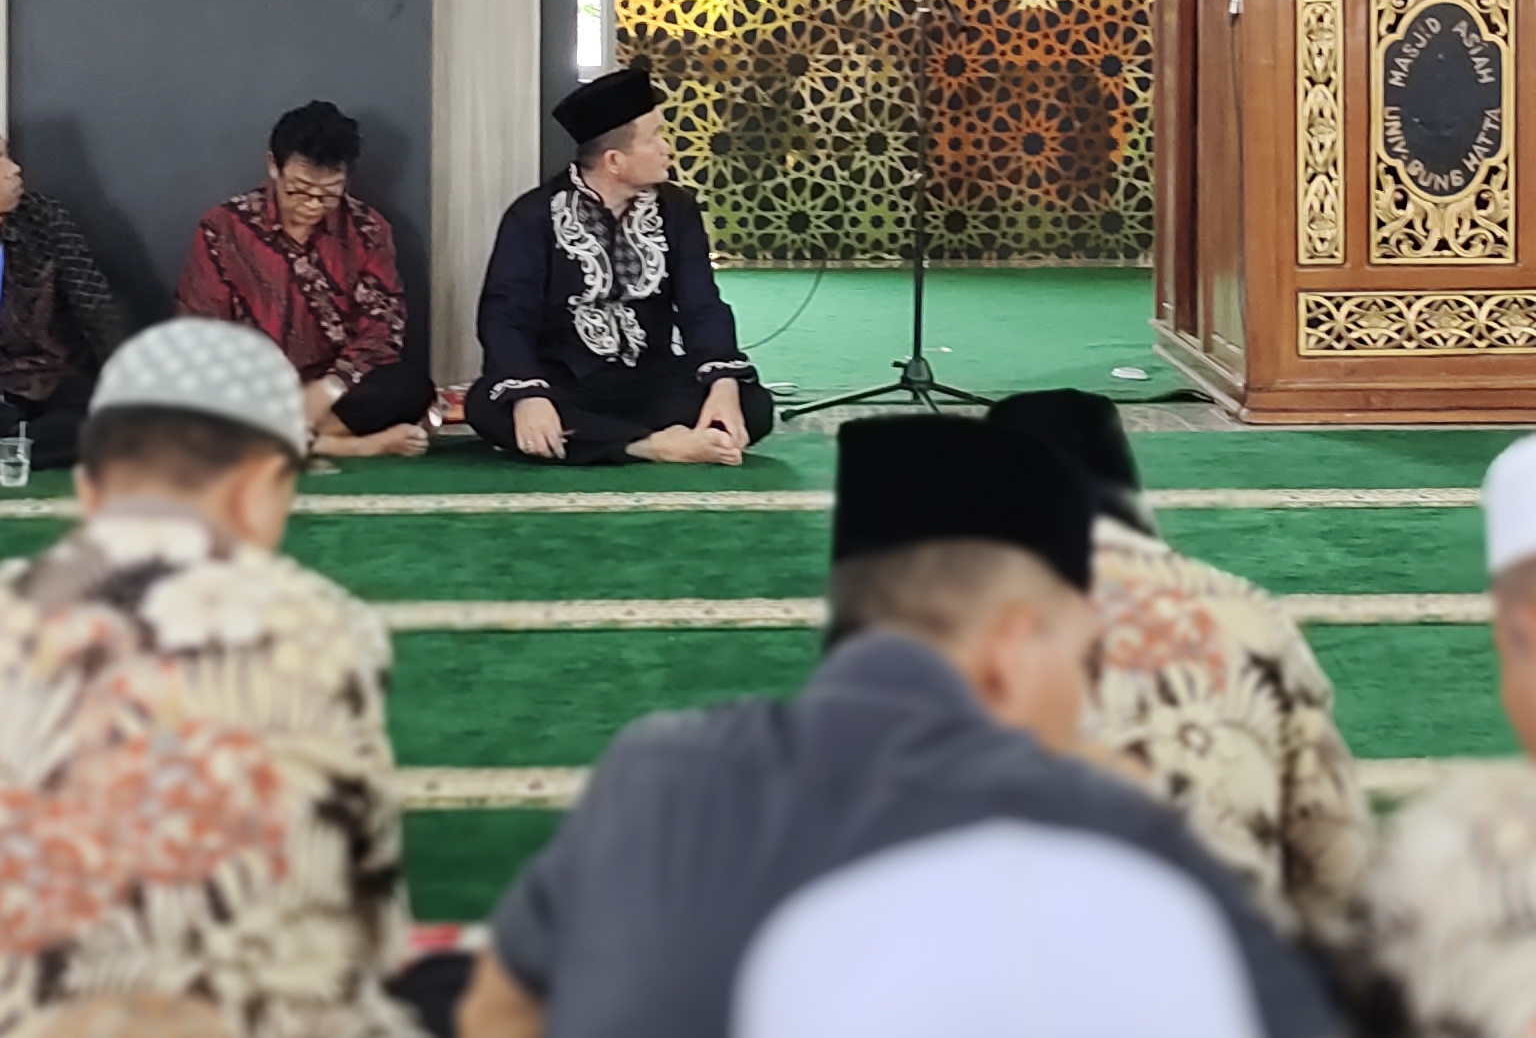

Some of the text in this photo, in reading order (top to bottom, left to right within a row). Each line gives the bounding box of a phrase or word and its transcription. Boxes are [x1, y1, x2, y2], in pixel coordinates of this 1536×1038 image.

[1387, 17, 1442, 88] MASJID
[1407, 158, 1465, 191] BUNG
[1461, 107, 1502, 173] HATTA
